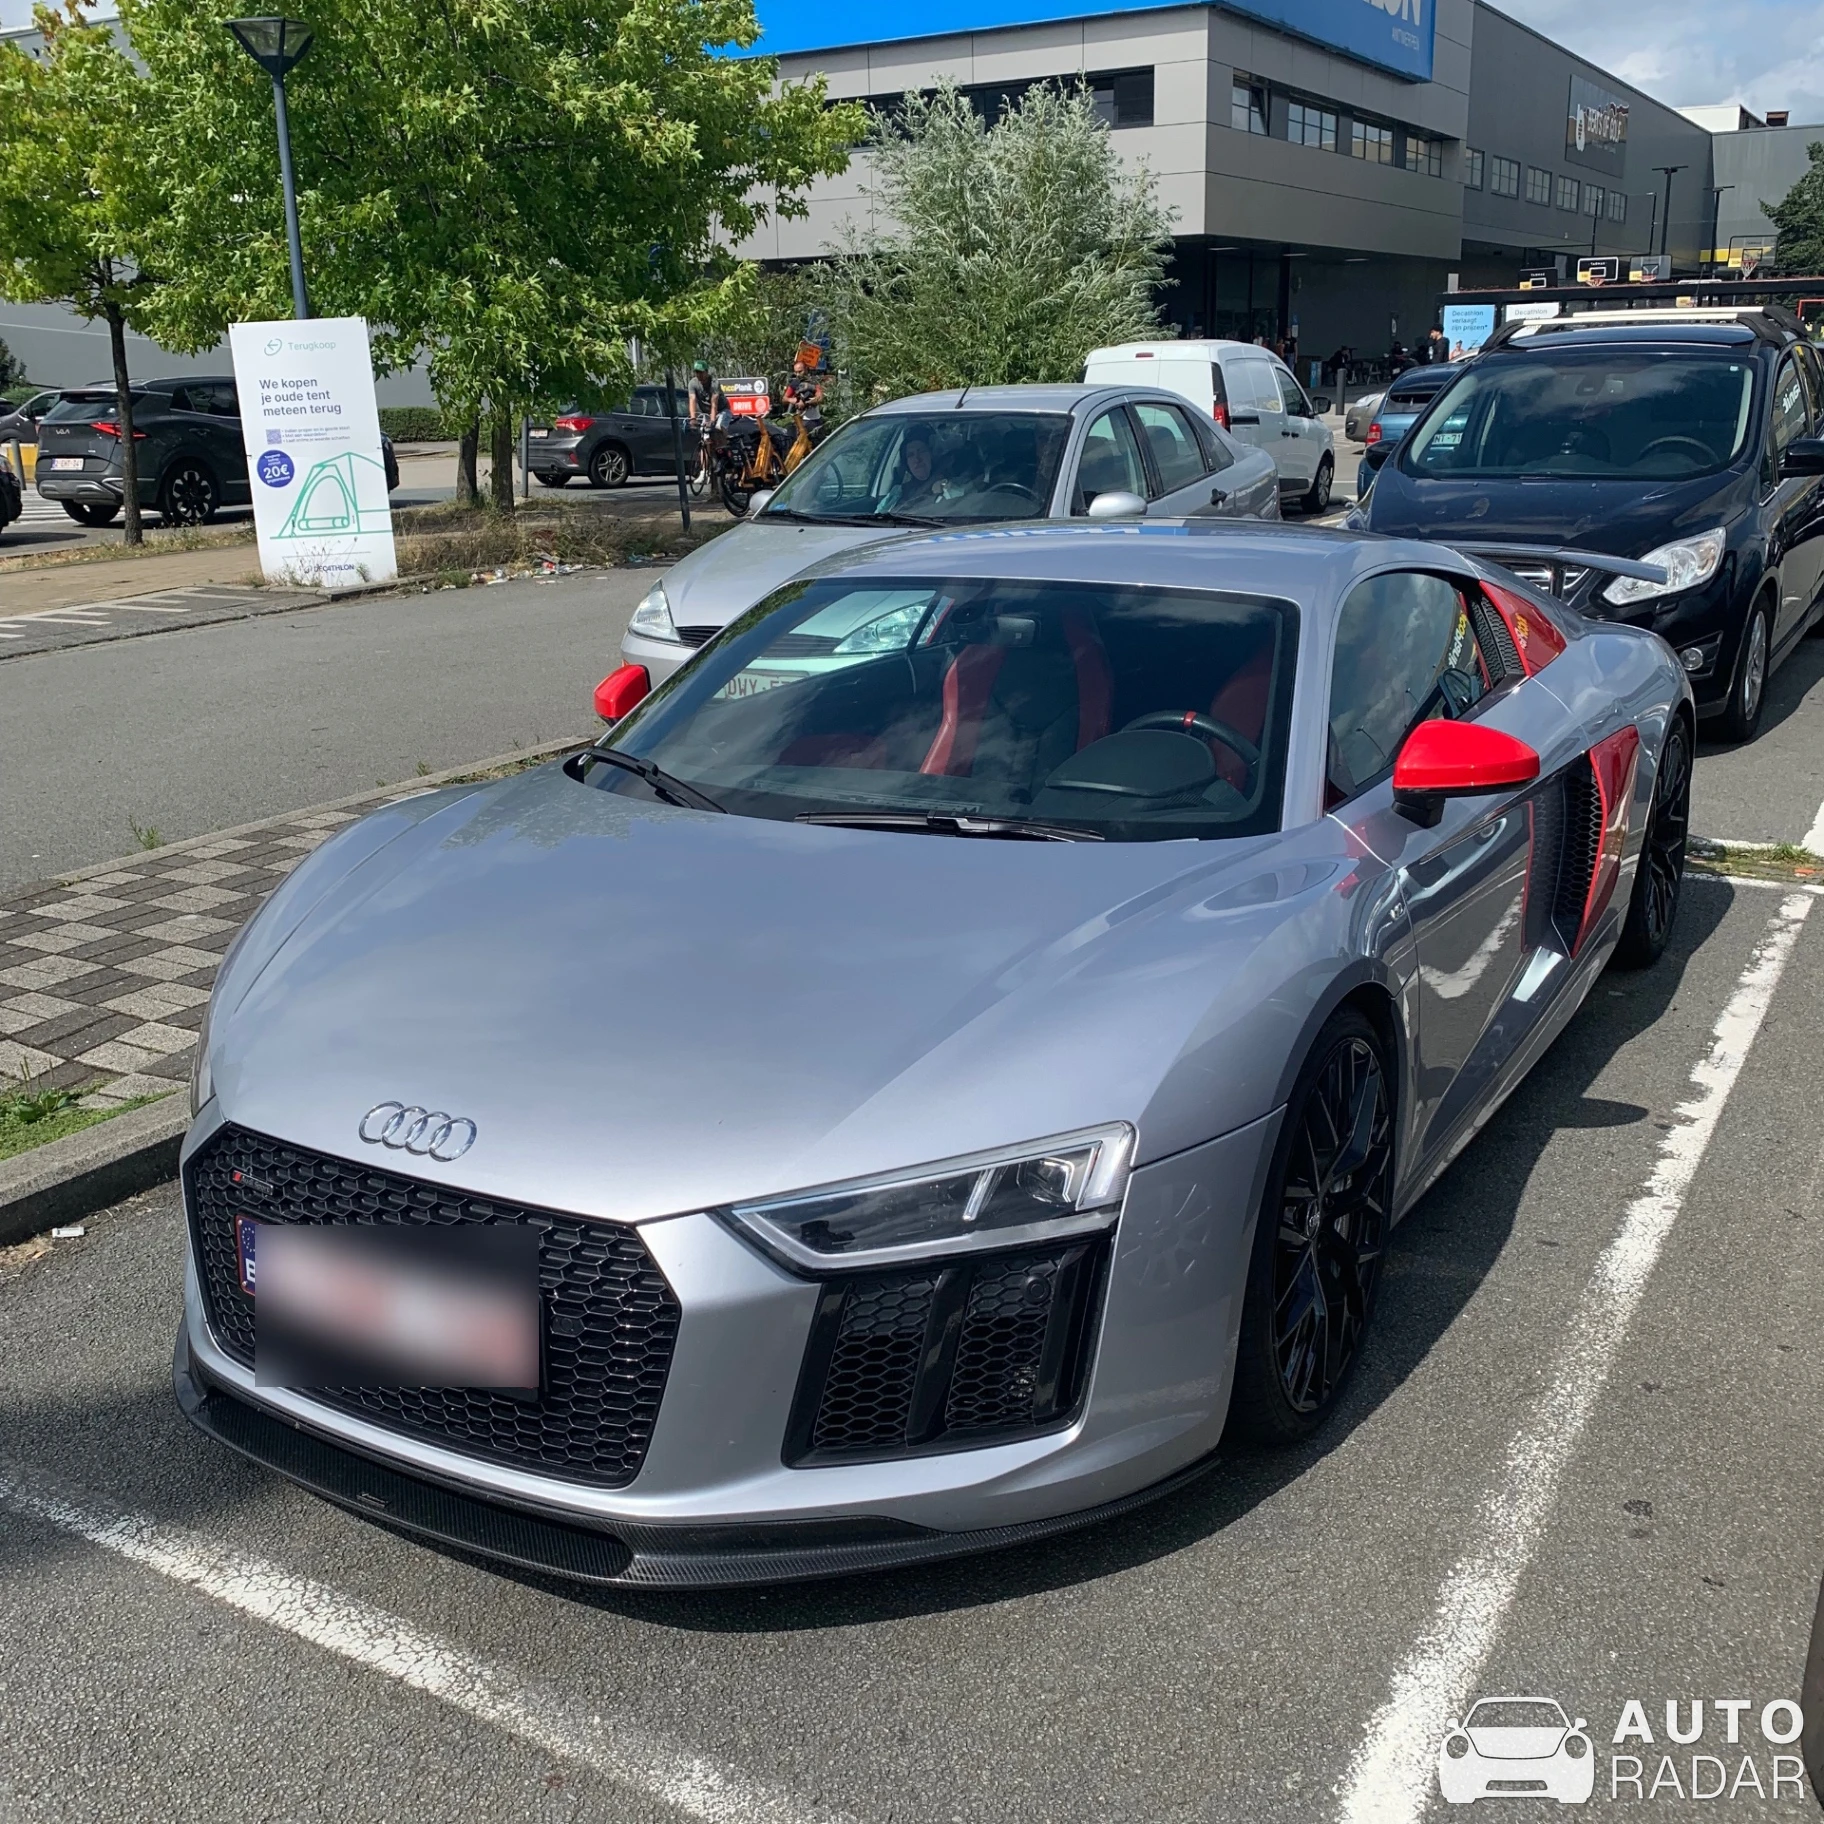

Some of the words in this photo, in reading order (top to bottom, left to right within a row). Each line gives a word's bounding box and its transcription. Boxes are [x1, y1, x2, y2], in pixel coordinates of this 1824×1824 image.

[1451, 309, 1484, 317] Decathlon
[1514, 308, 1548, 316] Decathlon
[1451, 317, 1478, 325] verlaagt
[287, 341, 337, 352] Terugkoop
[258, 379, 279, 390] We
[280, 377, 318, 391] kopen
[260, 392, 272, 406] je
[274, 390, 304, 403] oude
[306, 390, 331, 401] tent
[263, 404, 307, 417] meteen
[309, 403, 342, 415] terug
[733, 401, 753, 411] DRIVE
[263, 464, 290, 479] 20€
[314, 564, 355, 573] DECATHLON
